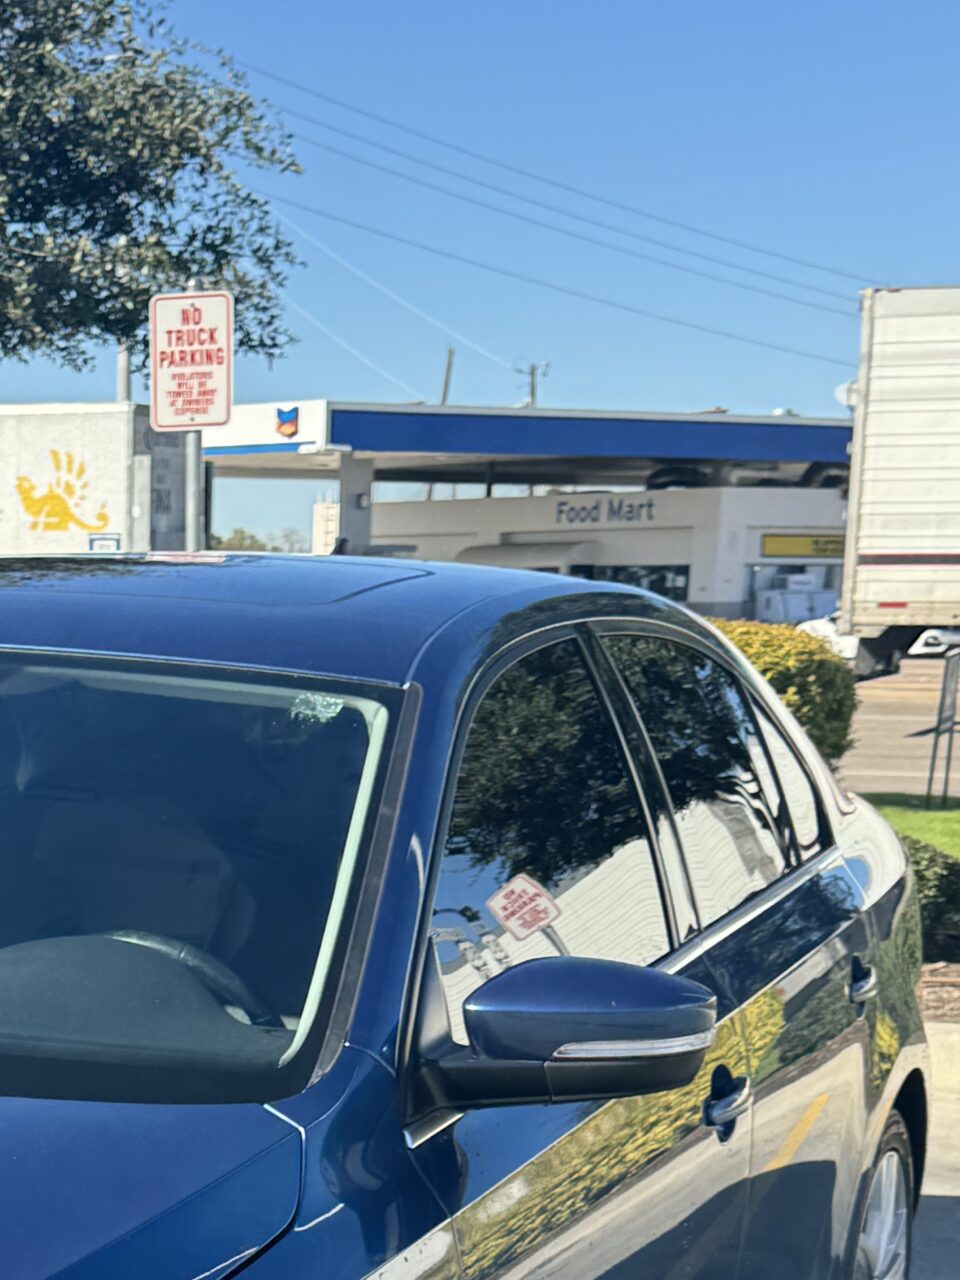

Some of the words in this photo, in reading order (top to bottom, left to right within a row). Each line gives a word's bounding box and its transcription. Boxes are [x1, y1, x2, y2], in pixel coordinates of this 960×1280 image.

[180, 307, 203, 326] NO
[165, 327, 219, 348] TRUCK
[159, 347, 225, 368] PARKING
[555, 499, 602, 524] Food
[606, 497, 656, 522] Mart
